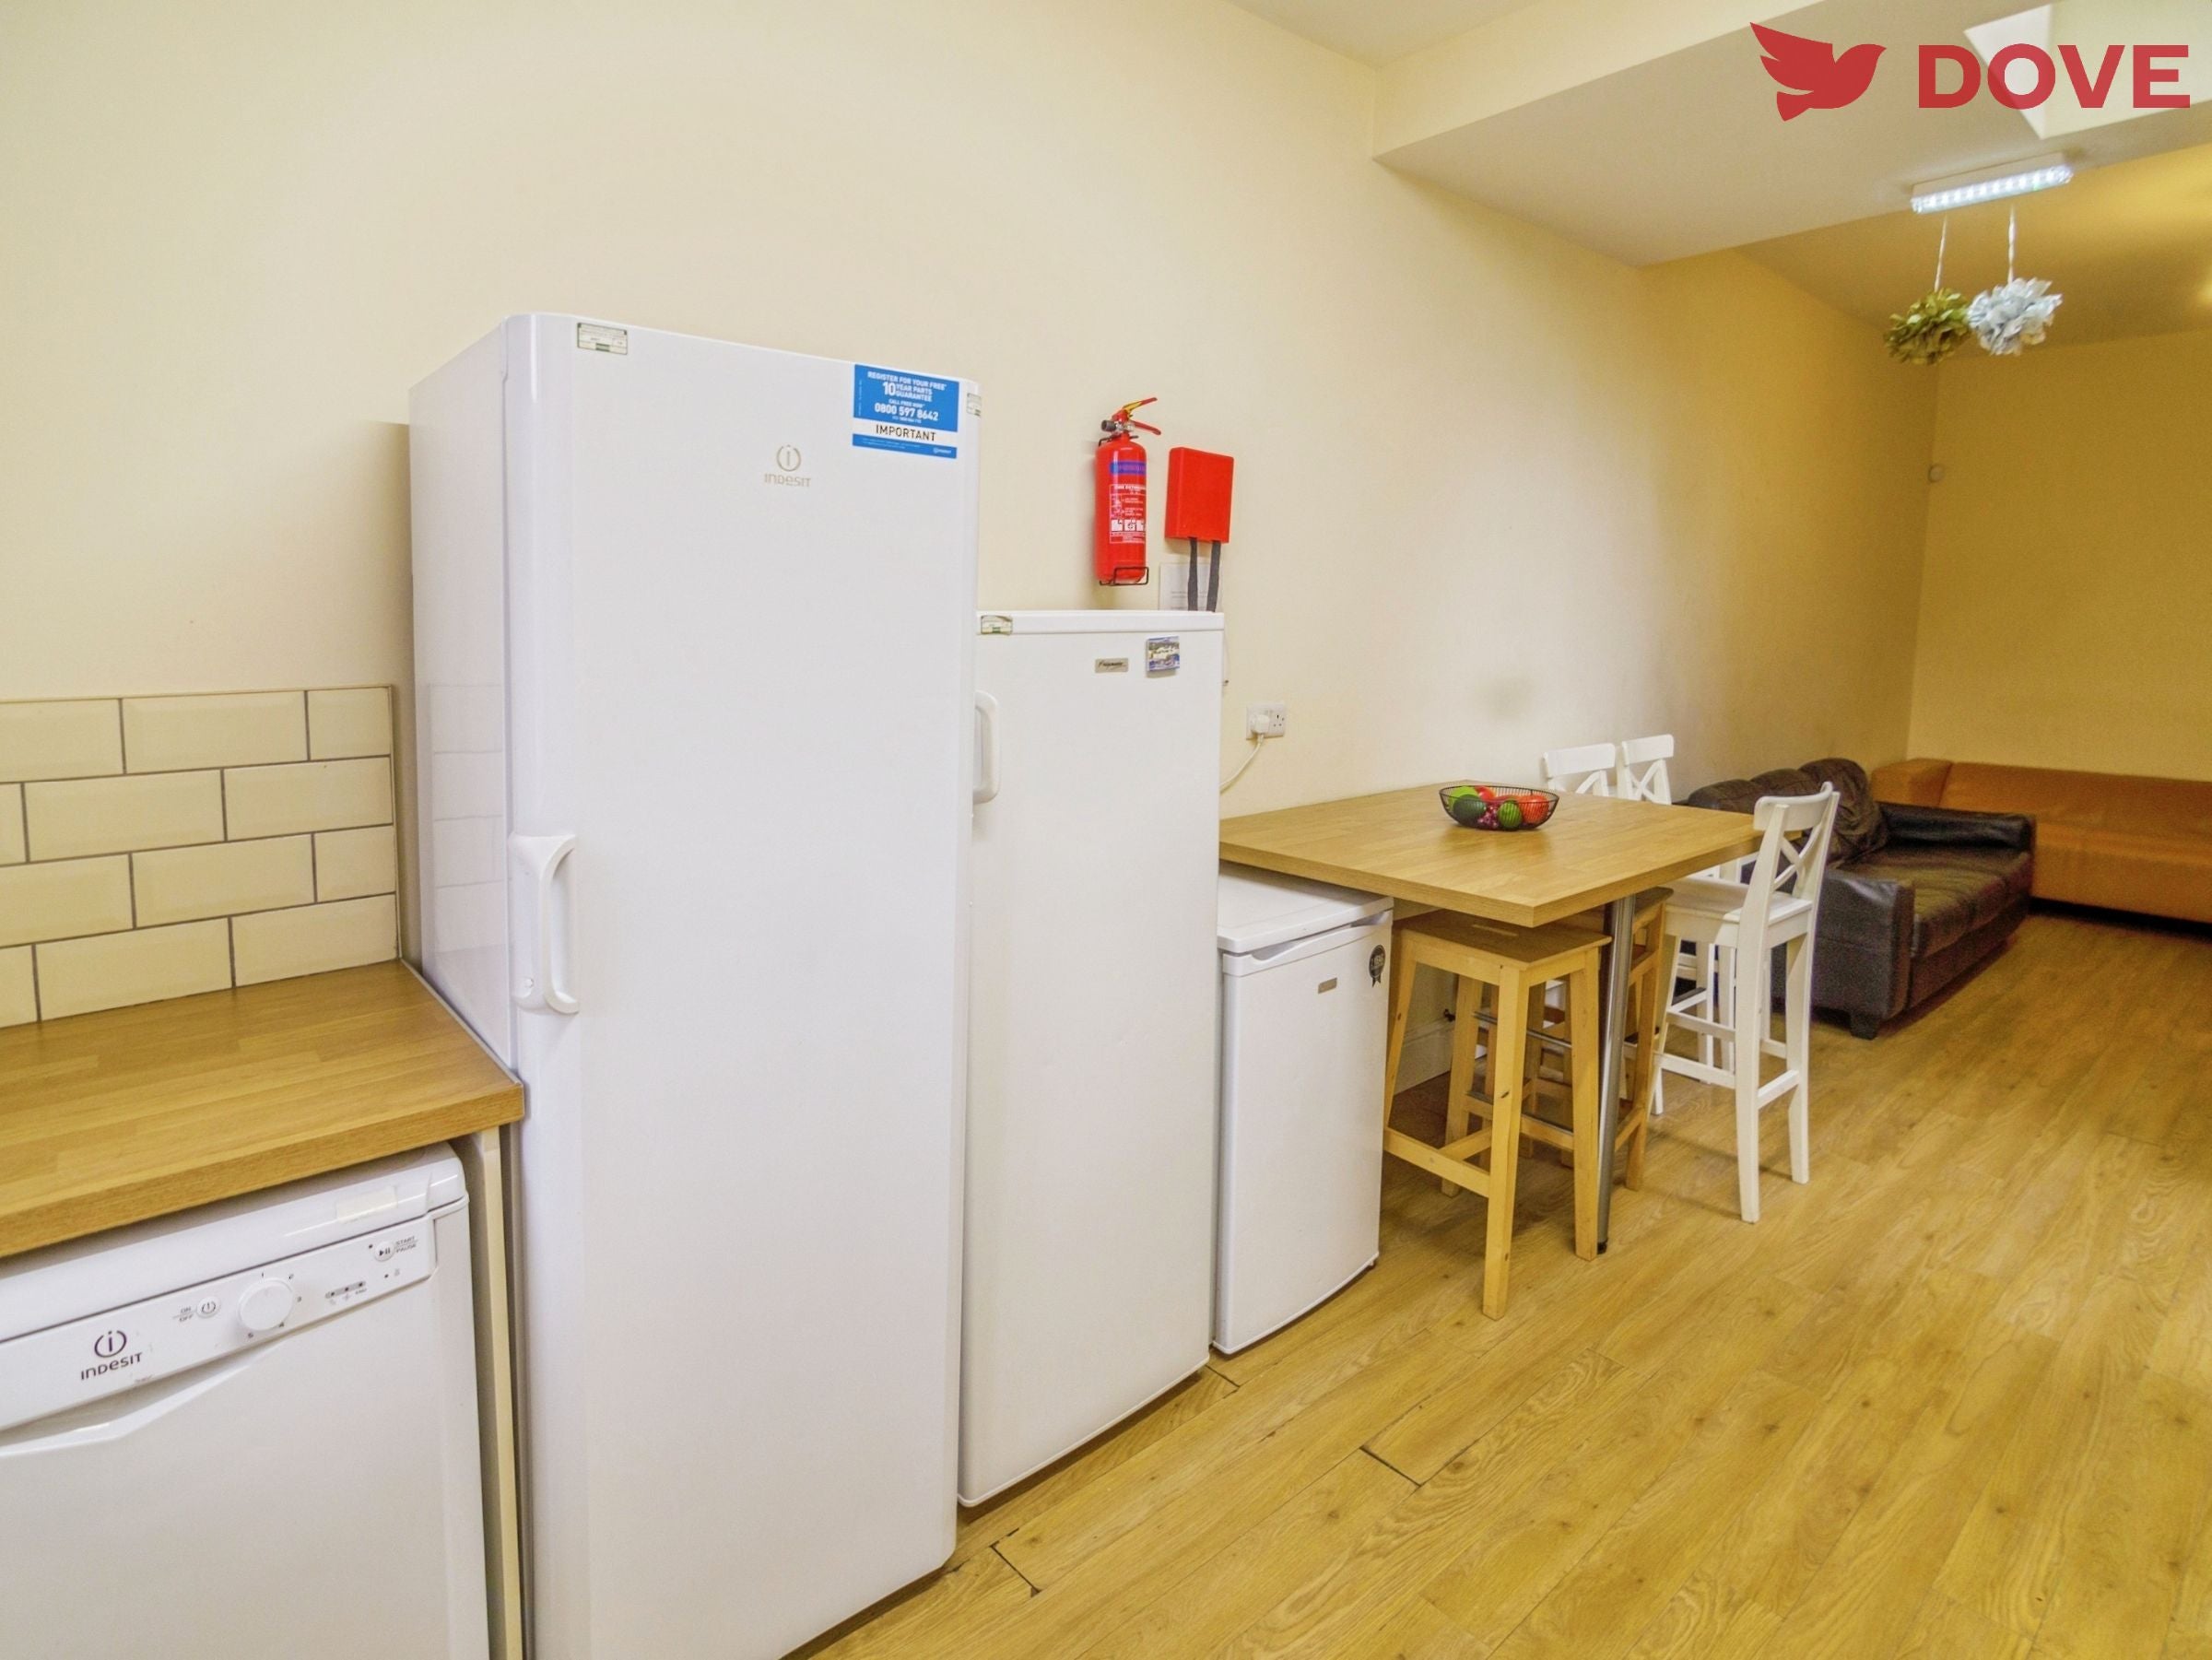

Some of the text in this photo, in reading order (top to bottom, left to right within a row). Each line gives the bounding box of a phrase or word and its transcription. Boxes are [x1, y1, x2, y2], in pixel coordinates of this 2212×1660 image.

[867, 371, 898, 383] REGISTER
[899, 376, 912, 385] FOR
[912, 379, 929, 387] YOUR
[882, 381, 896, 396] 10
[896, 383, 933, 394] YEAR PARTS
[896, 390, 933, 402] GUARANTEE
[874, 402, 897, 415] 0800
[899, 406, 915, 418] 597
[917, 409, 938, 421] 8642
[876, 424, 936, 441] IMPORTANT
